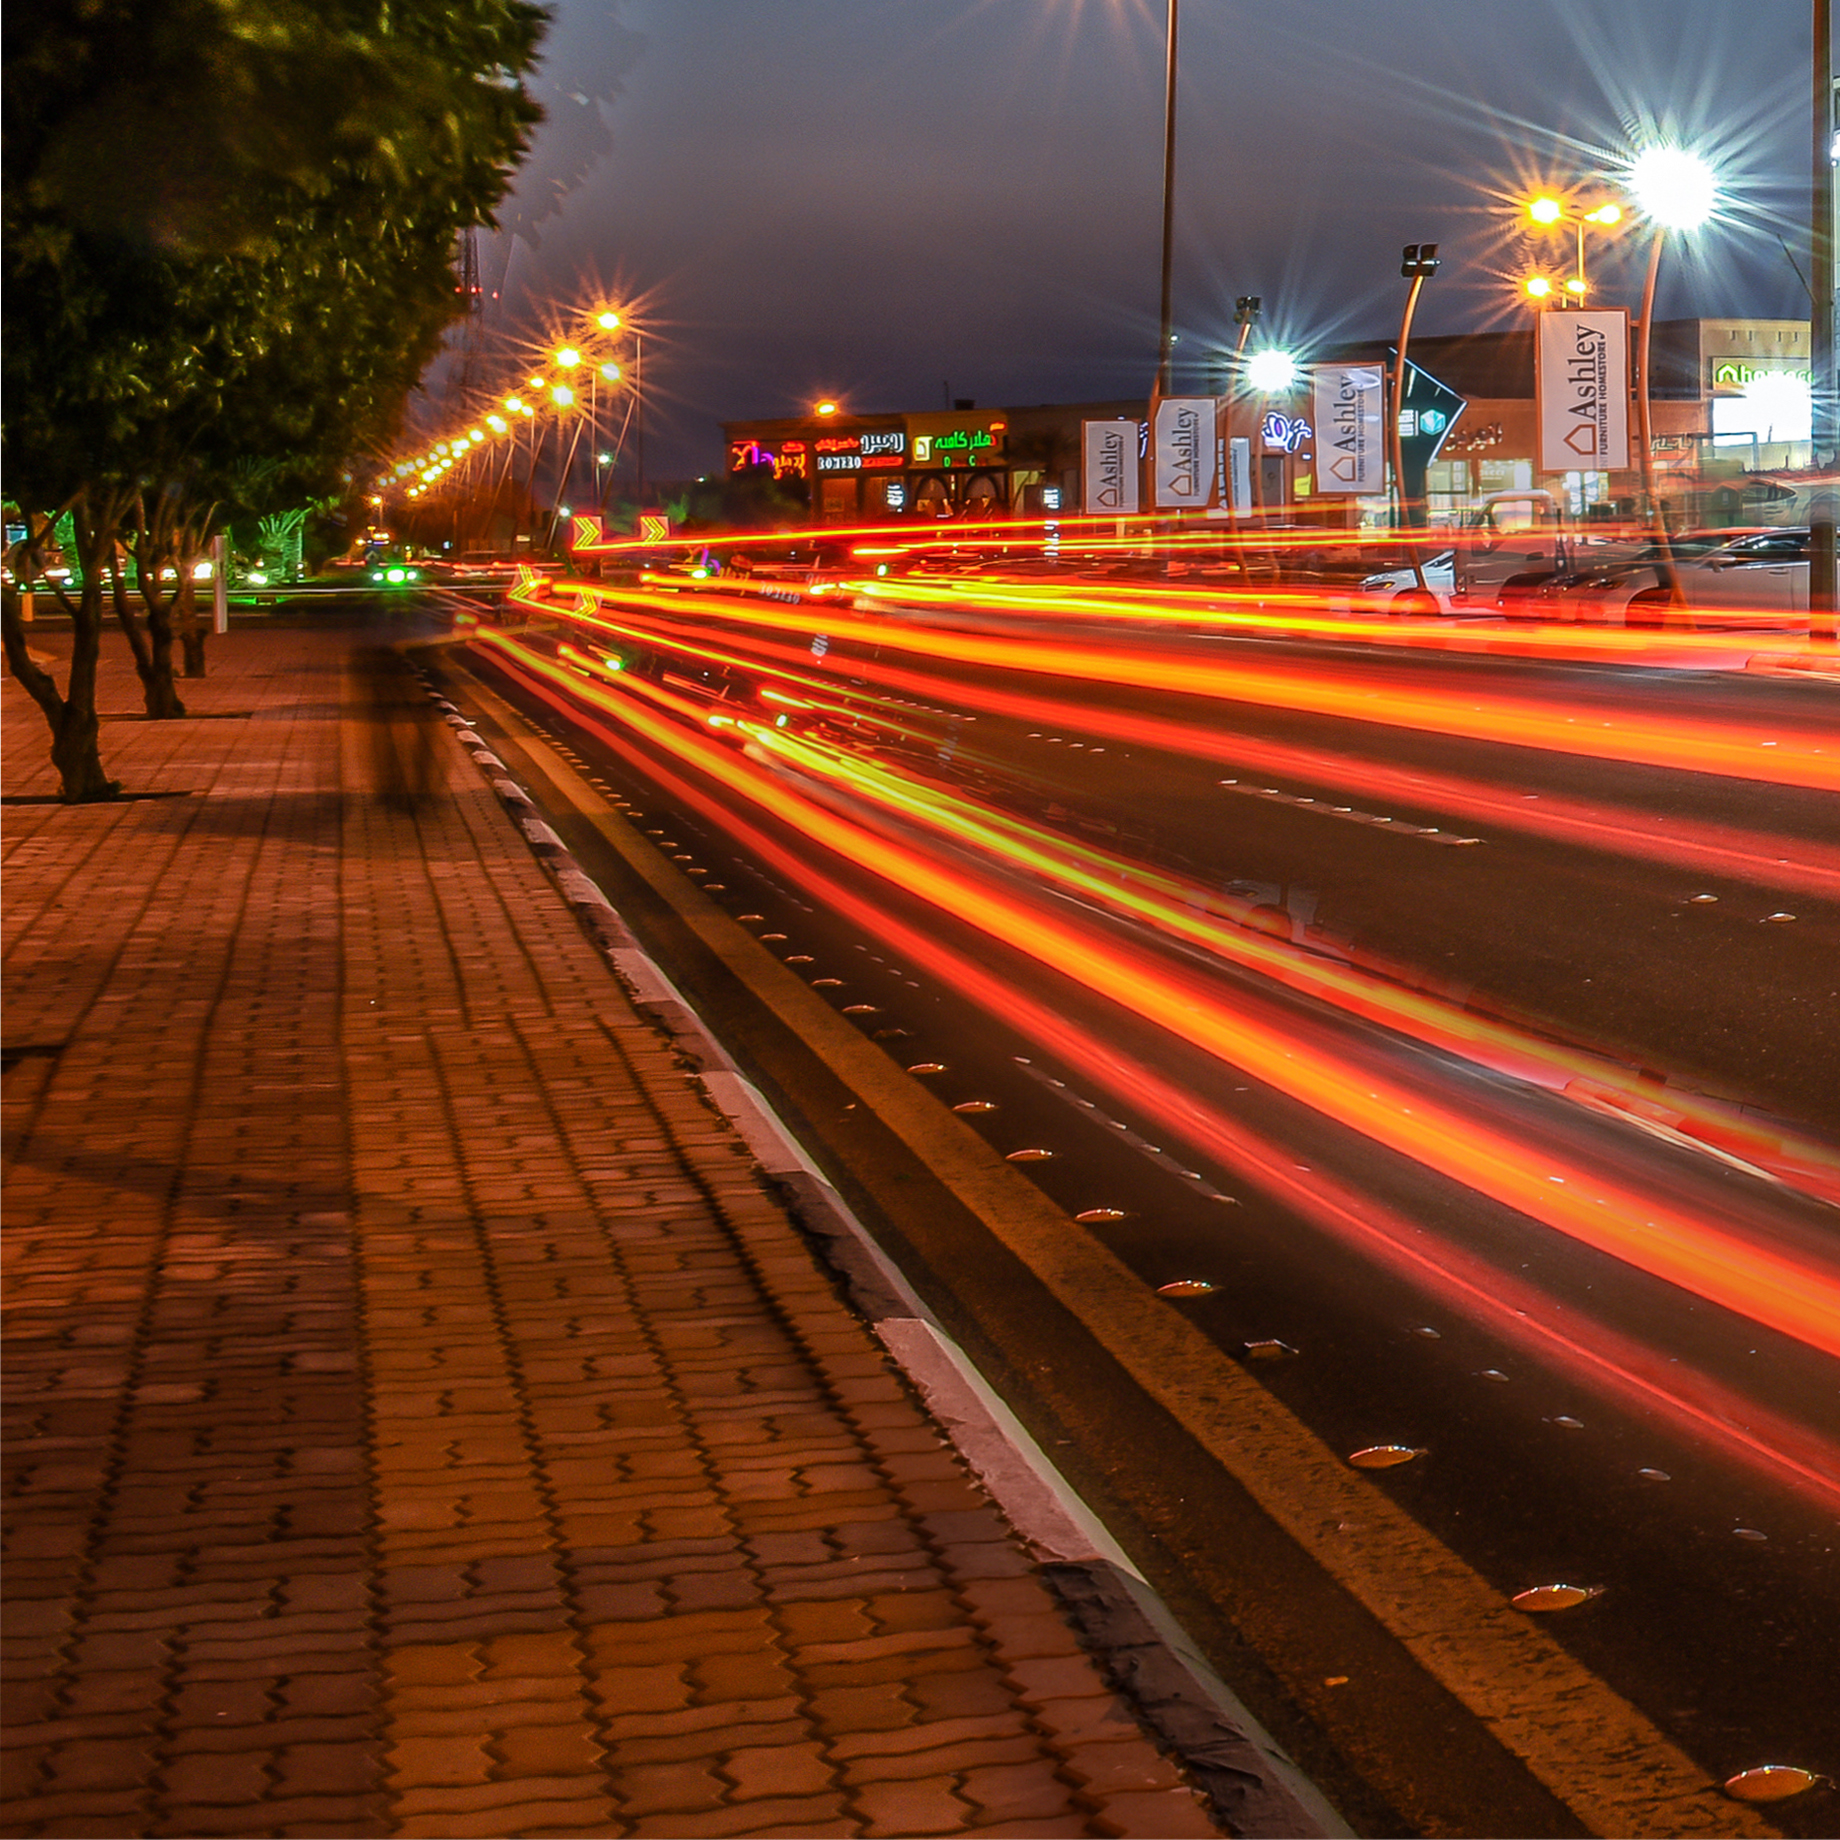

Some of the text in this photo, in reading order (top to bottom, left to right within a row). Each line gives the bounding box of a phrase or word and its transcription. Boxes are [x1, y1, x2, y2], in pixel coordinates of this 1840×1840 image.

[1567, 324, 1606, 422] Ashley
[1597, 341, 1608, 455] FURNITURE HOMESTORE
[1172, 408, 1199, 473] Ashley
[1333, 375, 1357, 453] Ashley
[1100, 431, 1123, 487] Ashley
